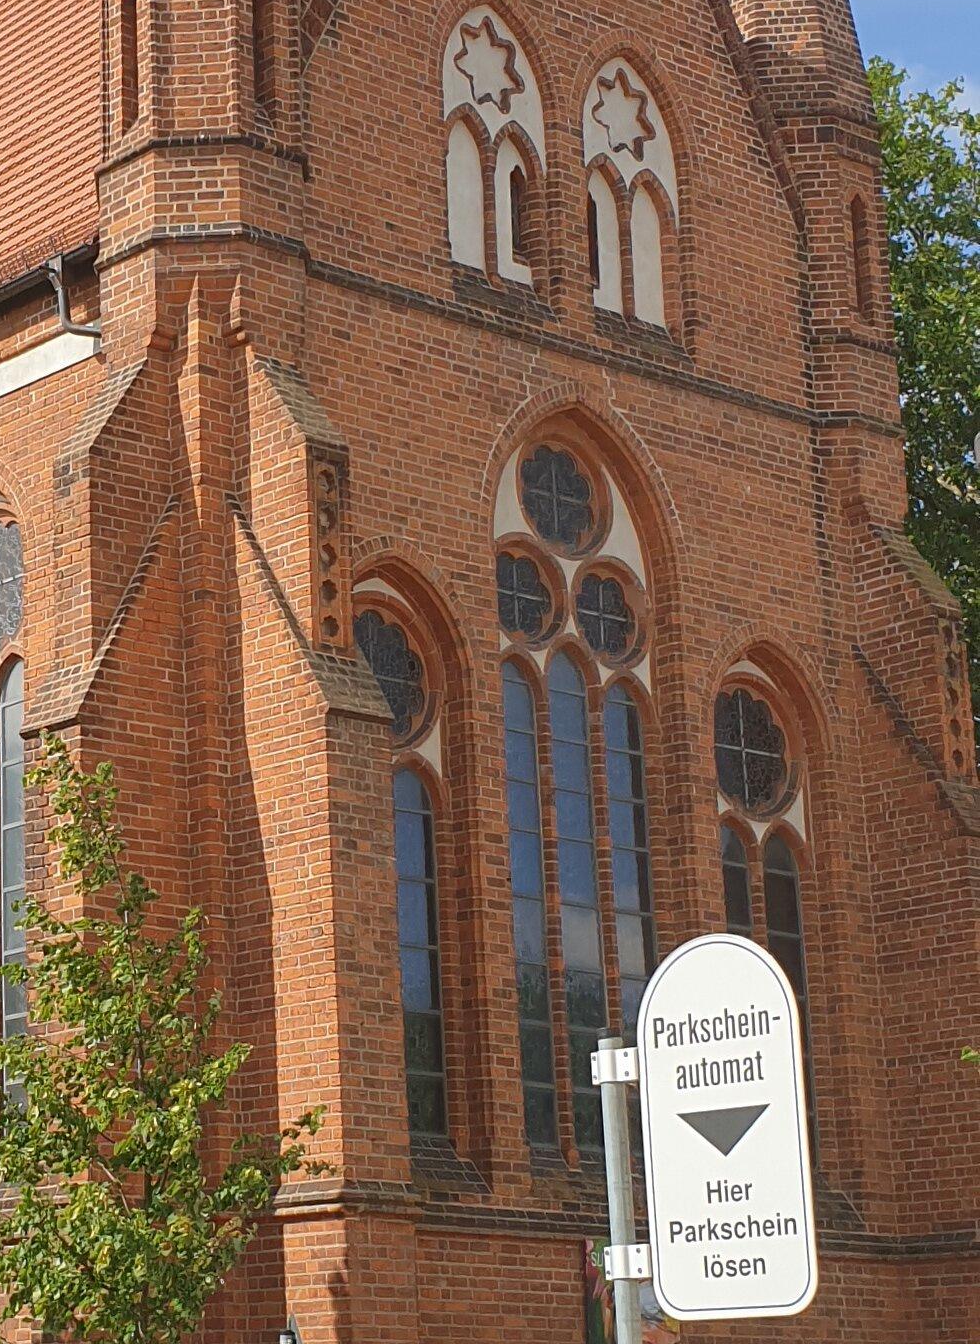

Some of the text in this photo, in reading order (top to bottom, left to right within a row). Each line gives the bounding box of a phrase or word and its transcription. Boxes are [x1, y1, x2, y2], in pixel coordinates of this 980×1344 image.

[653, 1005, 781, 1048] Parkschein-
[676, 1051, 764, 1089] automat
[706, 1180, 753, 1204] Hier
[669, 1213, 798, 1243] Parkschein
[704, 1254, 766, 1278] lösen
